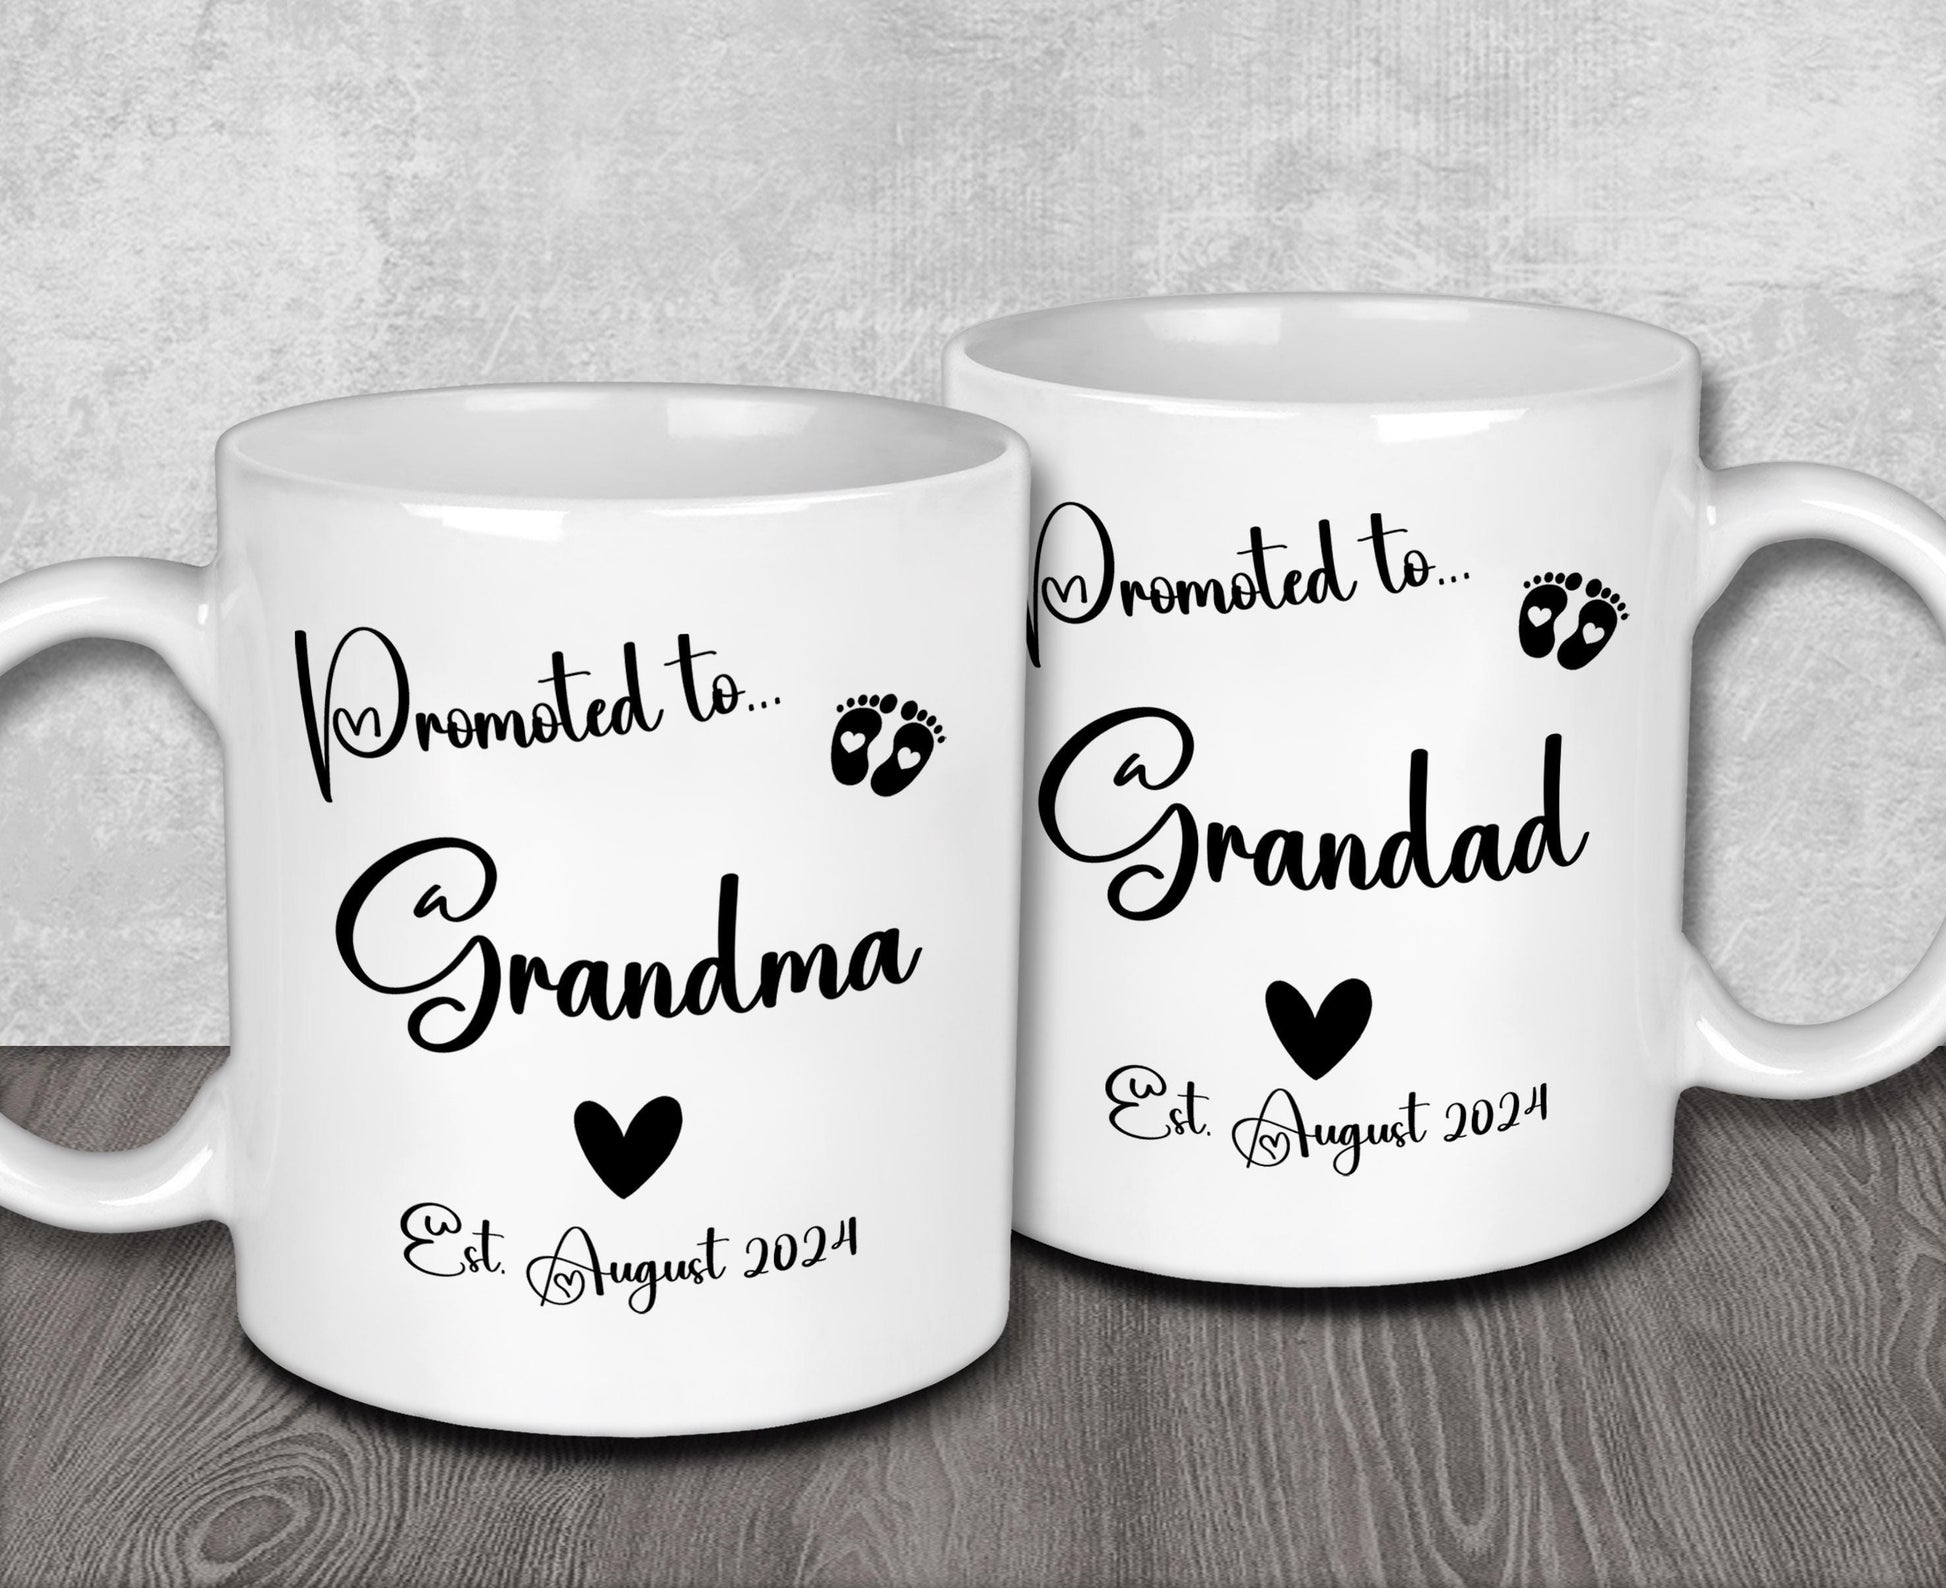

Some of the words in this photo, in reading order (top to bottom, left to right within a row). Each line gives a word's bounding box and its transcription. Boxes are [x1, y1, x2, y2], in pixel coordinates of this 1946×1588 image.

[1026, 502, 1357, 668] Promoted
[1358, 513, 1470, 593] to...
[294, 626, 664, 802] Promoted
[664, 633, 781, 722] to...
[1038, 706, 1590, 921] Grandad
[335, 836, 923, 1053] Grandma
[1104, 1064, 1210, 1140] Est.
[1232, 1088, 1430, 1176] August
[1443, 1083, 1548, 1142] 2024
[400, 1202, 505, 1277] Est.
[526, 1226, 730, 1314] August
[743, 1216, 857, 1278] 2024
